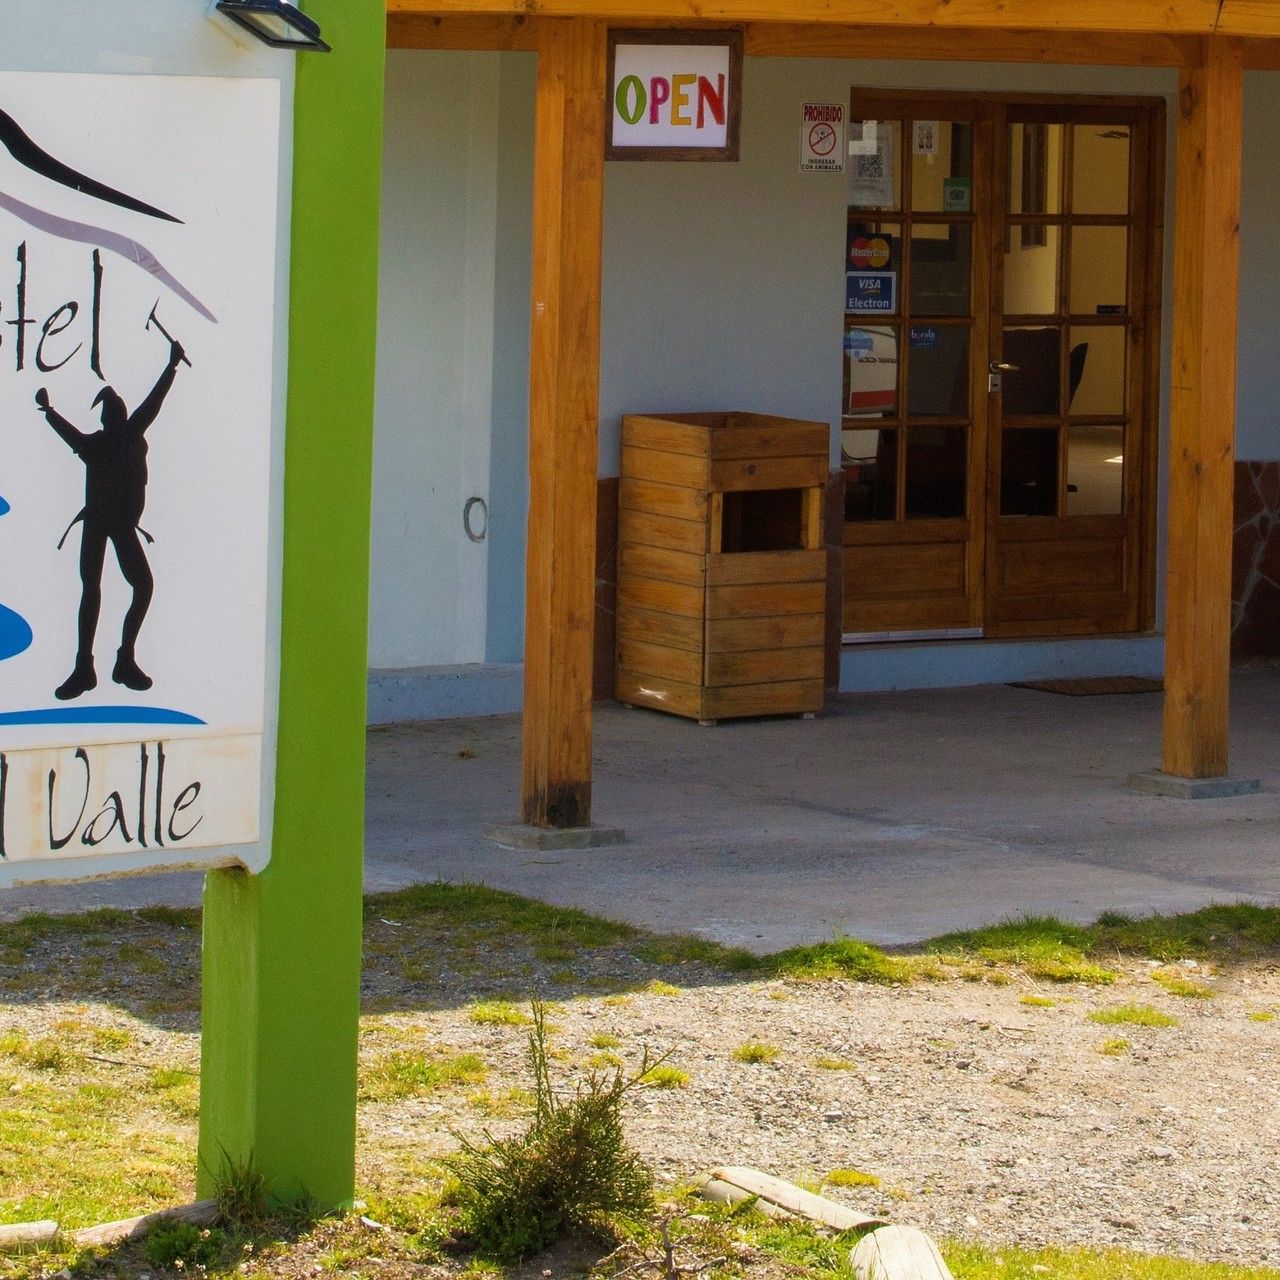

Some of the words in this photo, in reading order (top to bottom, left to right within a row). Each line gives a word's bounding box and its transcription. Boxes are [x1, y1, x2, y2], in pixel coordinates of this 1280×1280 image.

[615, 73, 725, 129] OPEN
[804, 106, 842, 122] PROHIBIDO
[859, 279, 881, 289] VISA
[849, 298, 889, 308] Electron
[47, 741, 203, 850] Valle
